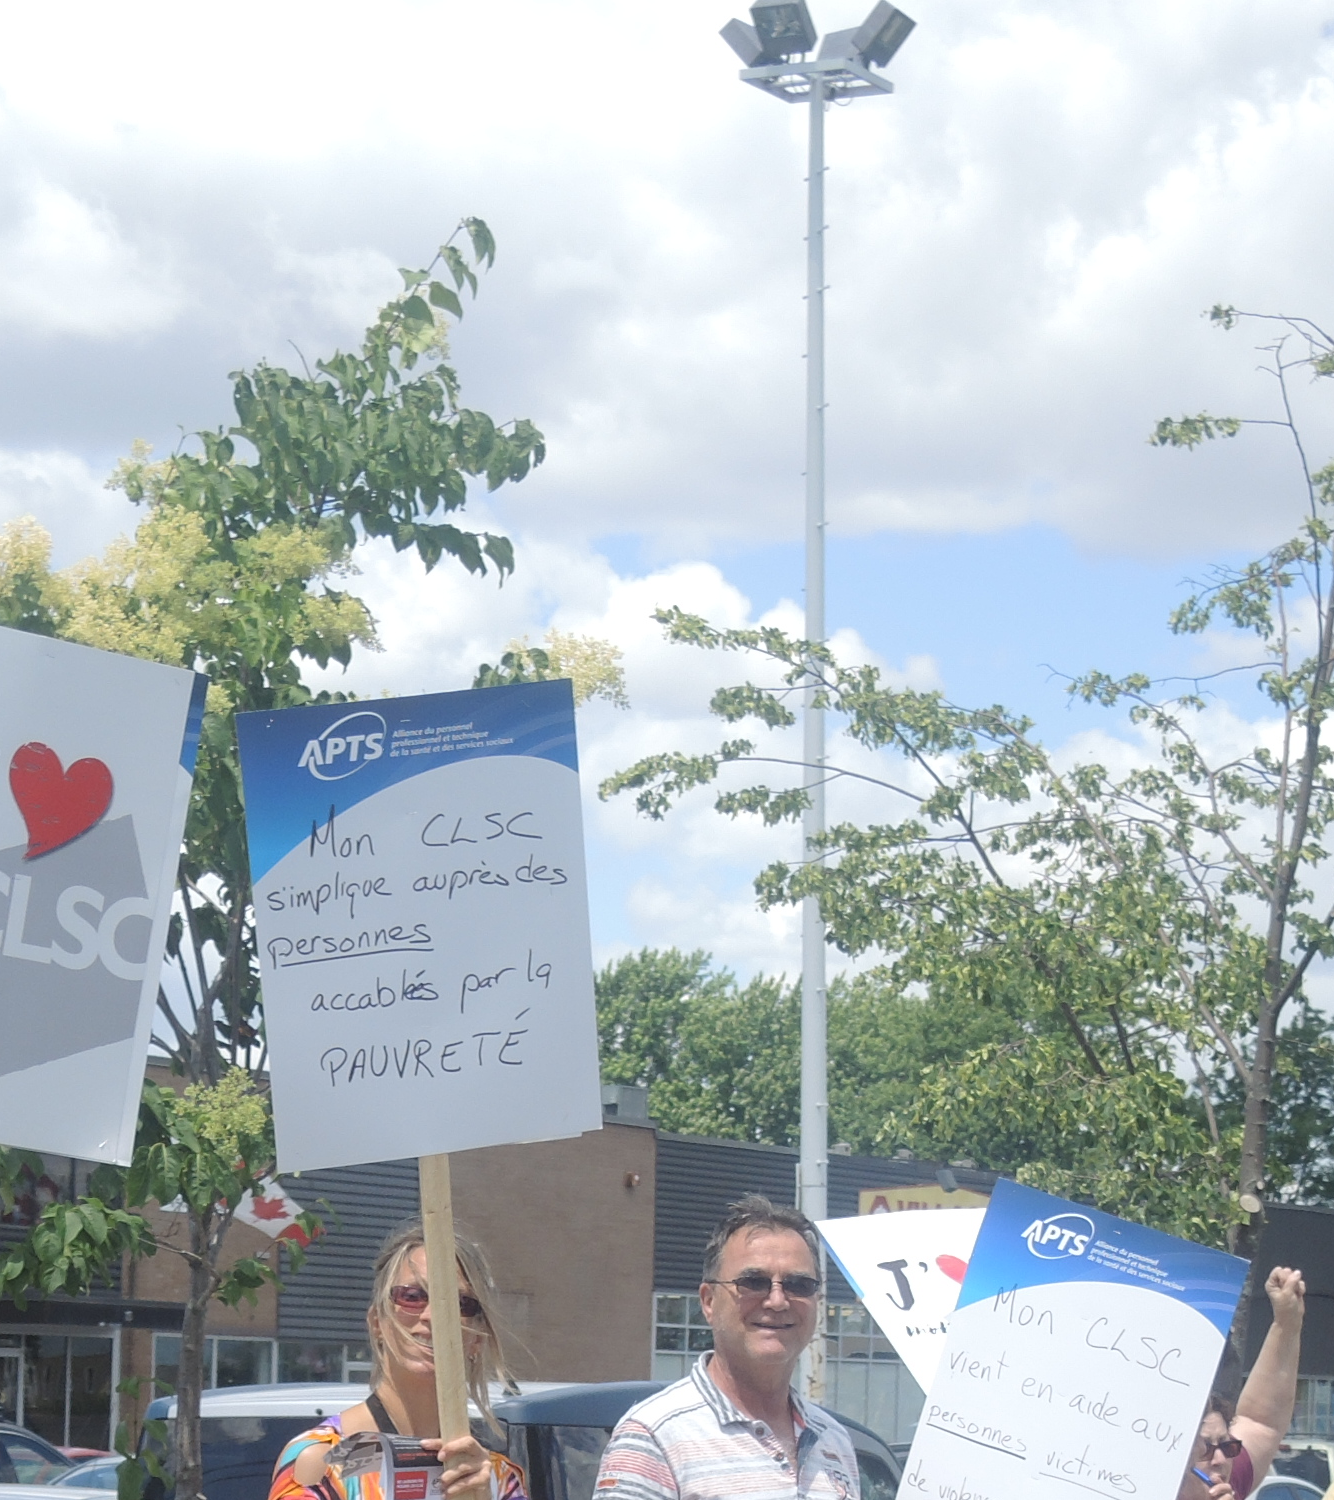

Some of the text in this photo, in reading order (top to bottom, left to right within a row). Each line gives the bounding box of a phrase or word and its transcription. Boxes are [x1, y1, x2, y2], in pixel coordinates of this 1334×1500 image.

[297, 733, 384, 767] APTS
[309, 803, 543, 859] Mon CLSC
[412, 860, 510, 900] auprès
[514, 854, 568, 886] des
[266, 922, 432, 970] personnes
[461, 966, 517, 1014] par
[320, 1007, 531, 1087] PAUVRETÉ
[1021, 1219, 1090, 1257] APTS
[993, 1283, 1191, 1388] Mon CLSC
[950, 1350, 1184, 1454] vient en aide aux
[928, 1404, 1138, 1495] personnes victimes
[907, 1459, 930, 1493] de
